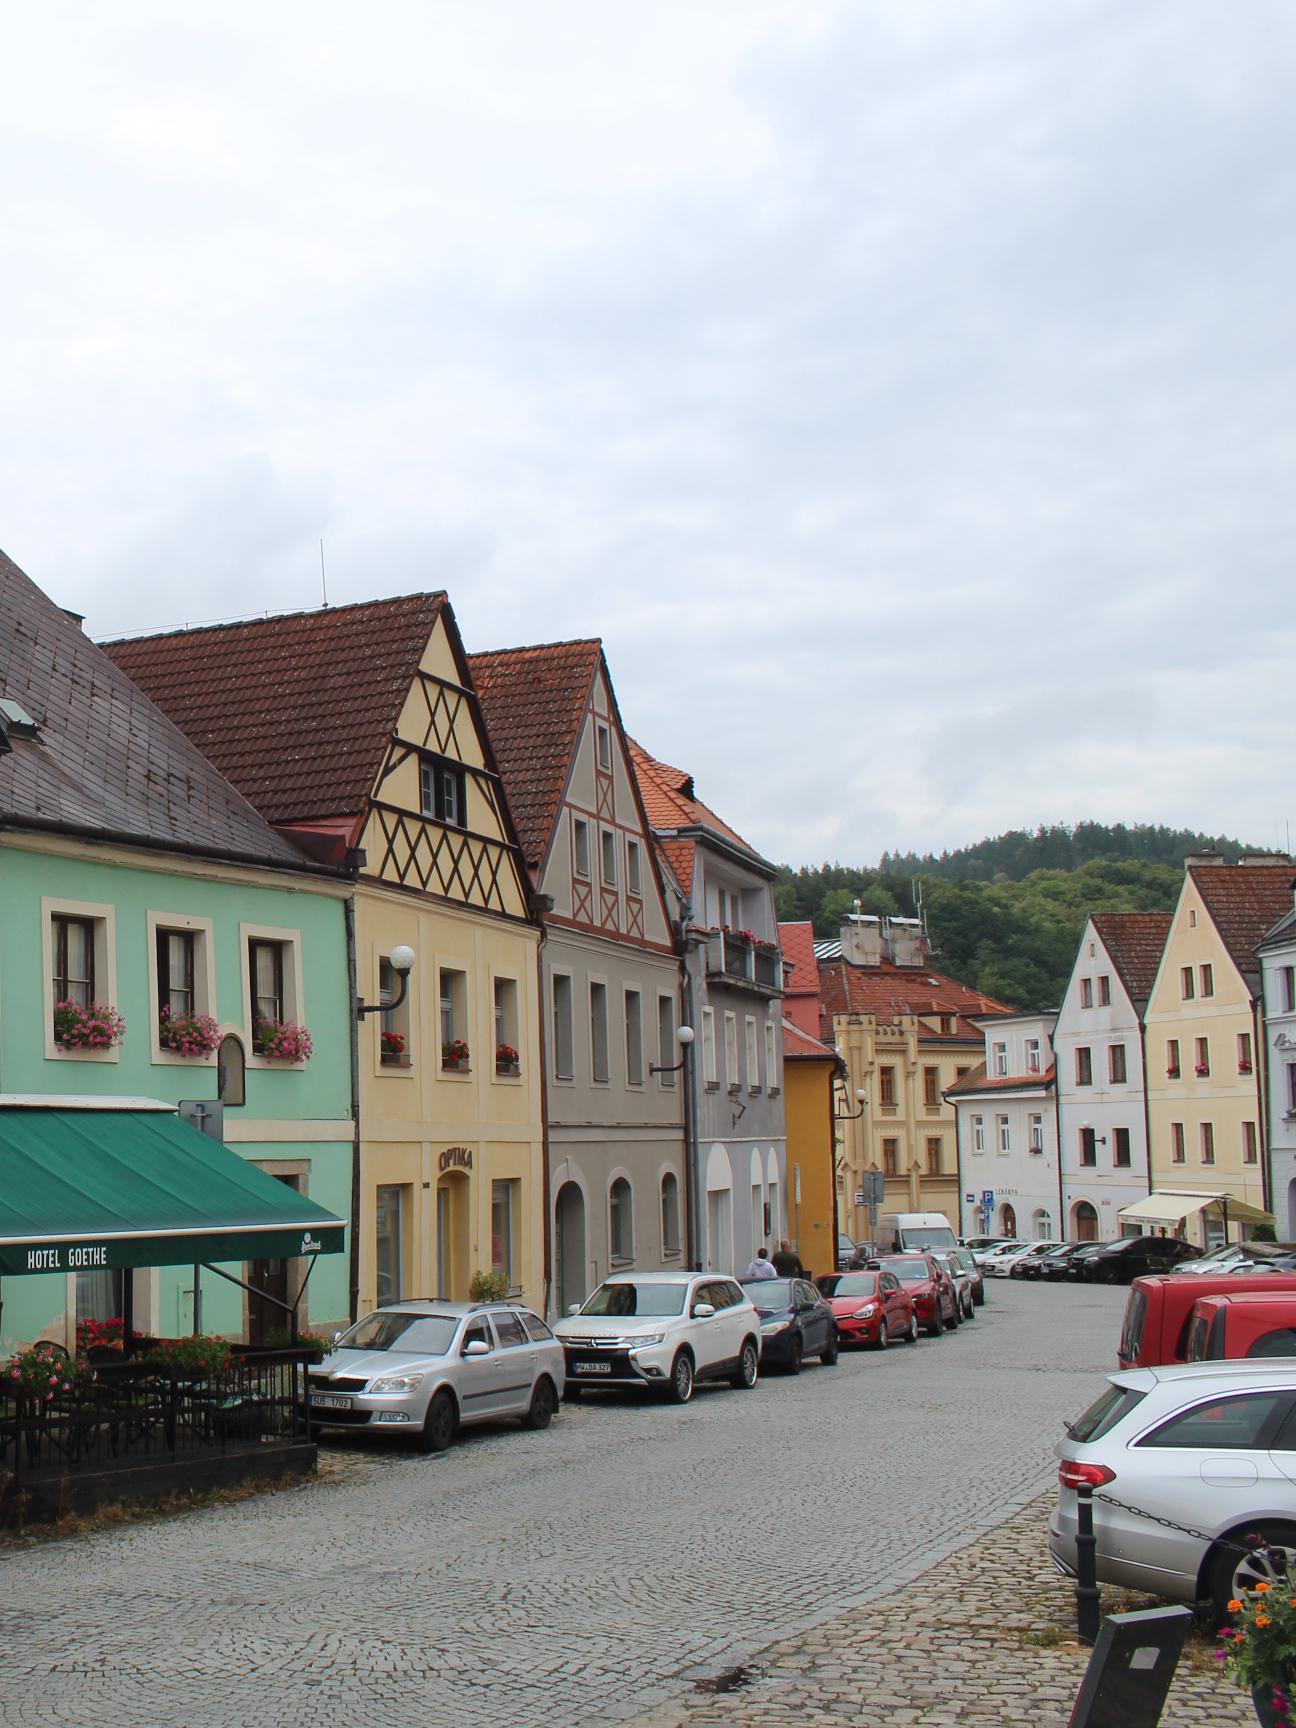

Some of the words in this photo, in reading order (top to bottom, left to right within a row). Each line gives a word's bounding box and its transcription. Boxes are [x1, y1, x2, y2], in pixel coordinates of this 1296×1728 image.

[438, 1146, 473, 1172] OPTIKA
[984, 1192, 992, 1202] P
[27, 1249, 61, 1270] HOTEL
[68, 1246, 108, 1267] GOETHE
